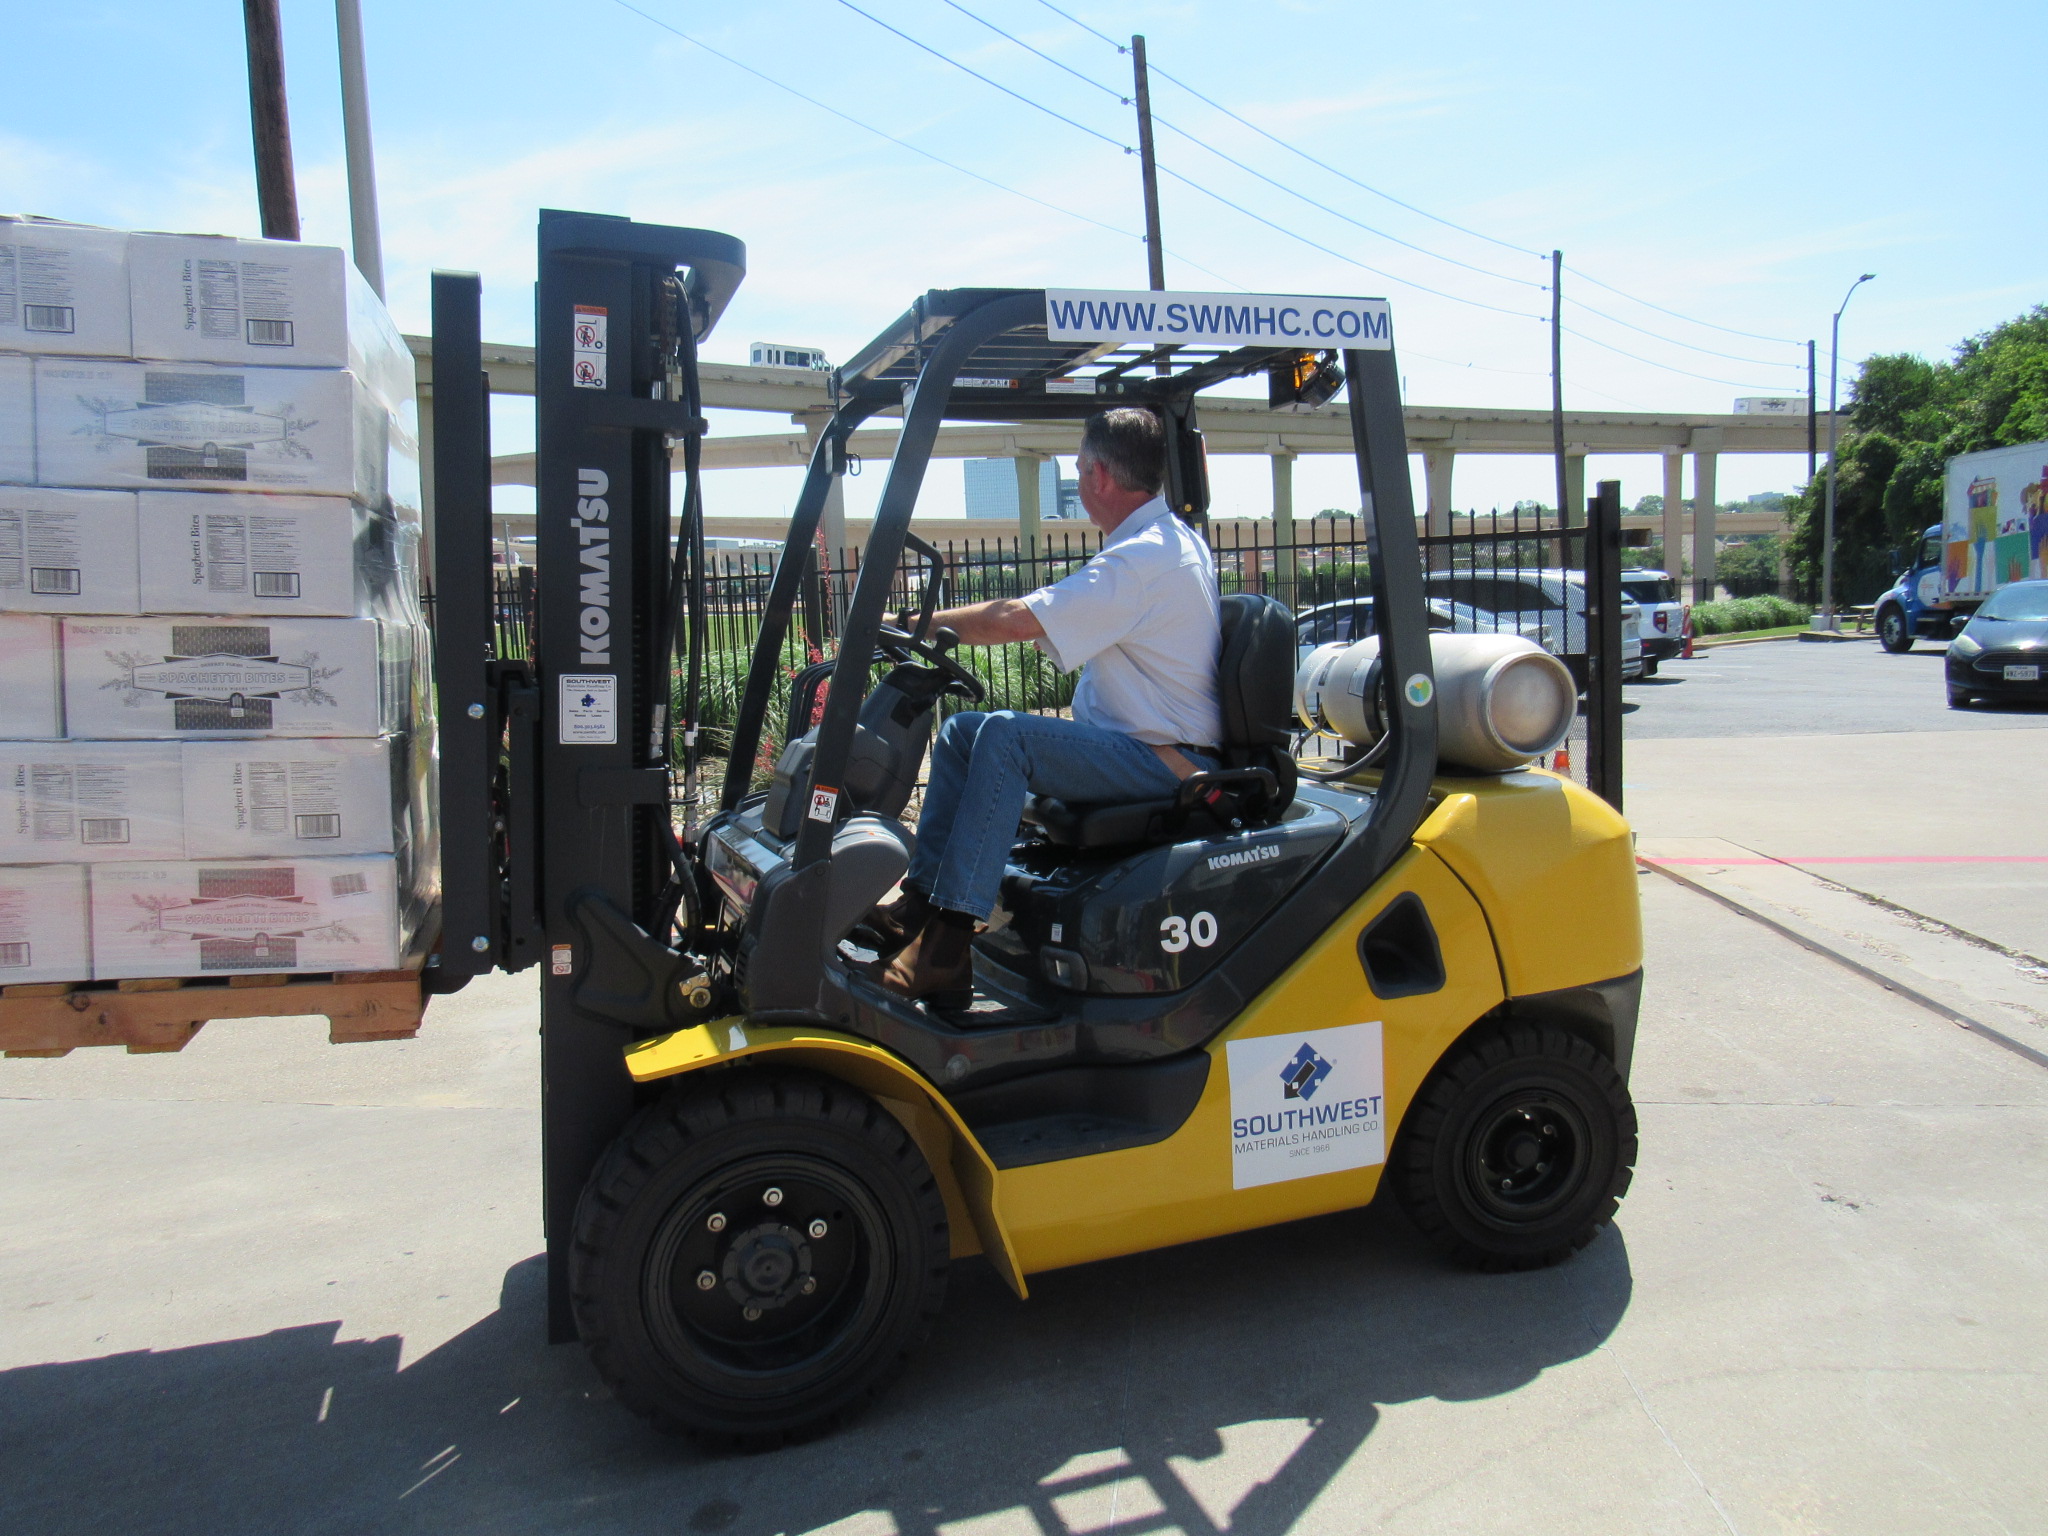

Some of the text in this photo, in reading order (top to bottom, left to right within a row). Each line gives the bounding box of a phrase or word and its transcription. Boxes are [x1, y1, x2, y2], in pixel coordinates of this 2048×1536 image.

[182, 259, 197, 331] Spaghetti Bites
[1050, 299, 1389, 339] WWW.SWMHC.COM
[219, 421, 261, 434] BITES
[190, 514, 205, 585] Spaghetti Bites
[570, 468, 610, 665] KOMATSU
[158, 672, 286, 684] SPAGHETTI BITES
[15, 765, 30, 834] Spaghei Bites
[232, 763, 248, 830] Spaghetti Bites
[1207, 845, 1280, 870] KOMATSU
[185, 911, 311, 925] SPAGHETTI BITES
[1160, 911, 1218, 954] 30
[1233, 1095, 1382, 1139] SOUTHWEST
[1235, 1133, 1299, 1154] MATERIALS
[1302, 1123, 1360, 1142] HANDLING
[1289, 1146, 1310, 1158] SINCE
